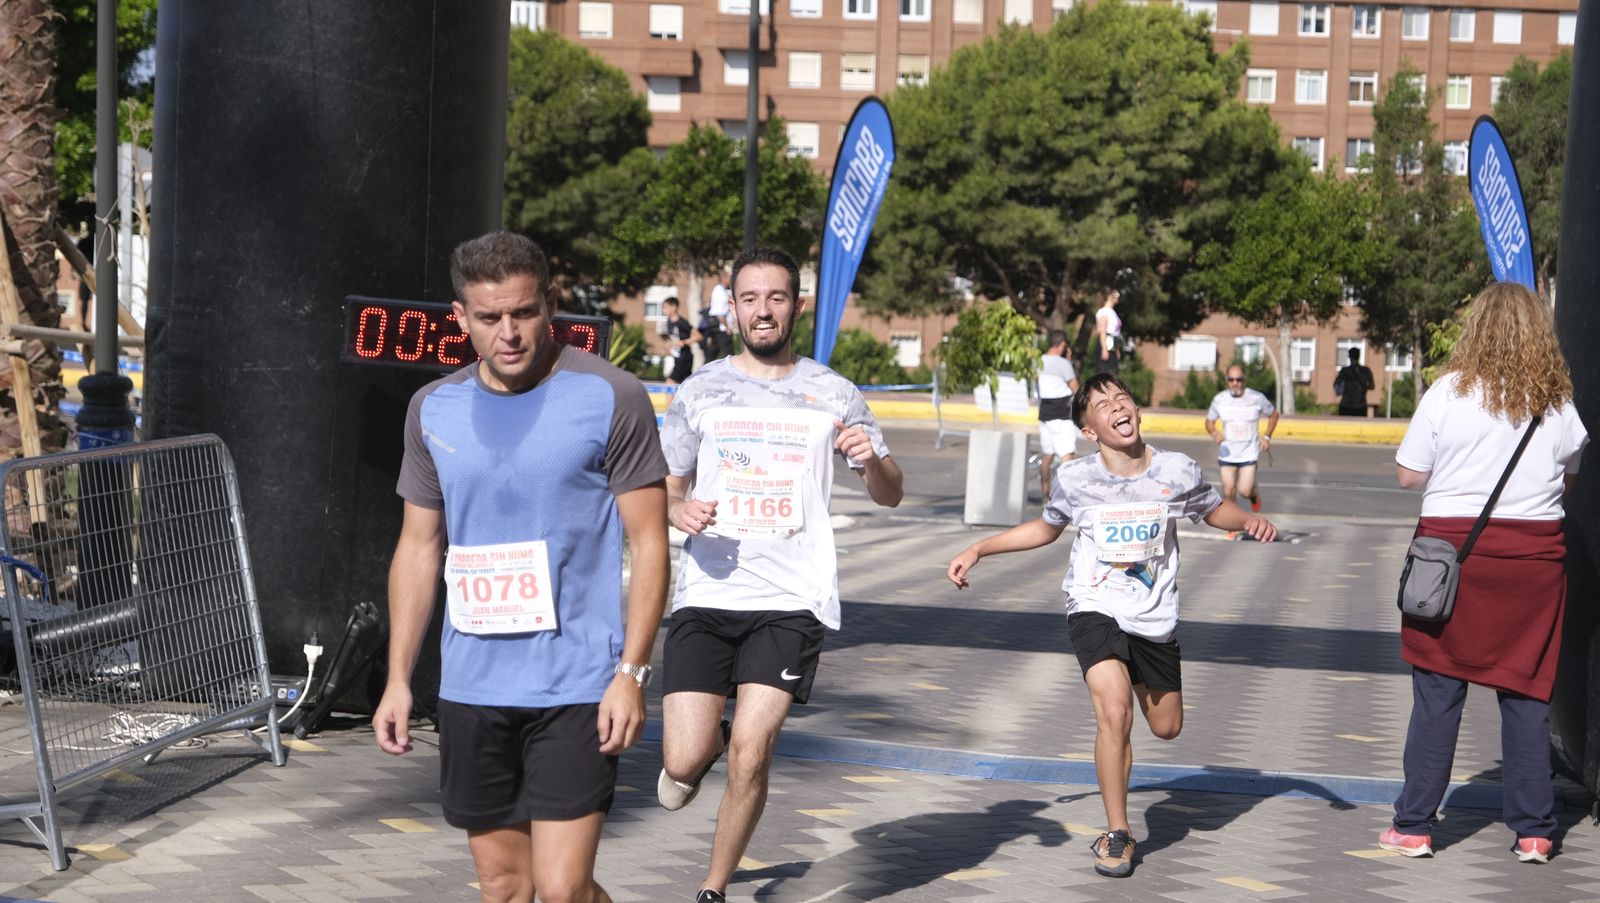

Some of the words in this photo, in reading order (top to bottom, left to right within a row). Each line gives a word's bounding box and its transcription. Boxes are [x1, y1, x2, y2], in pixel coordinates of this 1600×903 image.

[722, 421, 764, 431] CARRERA
[784, 423, 810, 434] HUMO
[781, 452, 806, 464] JUNIO
[728, 495, 793, 518] 1166
[1105, 522, 1161, 543] 2060
[457, 572, 540, 603] 1078
[472, 605, 490, 615] JUAN
[491, 603, 525, 614] MANUEL
